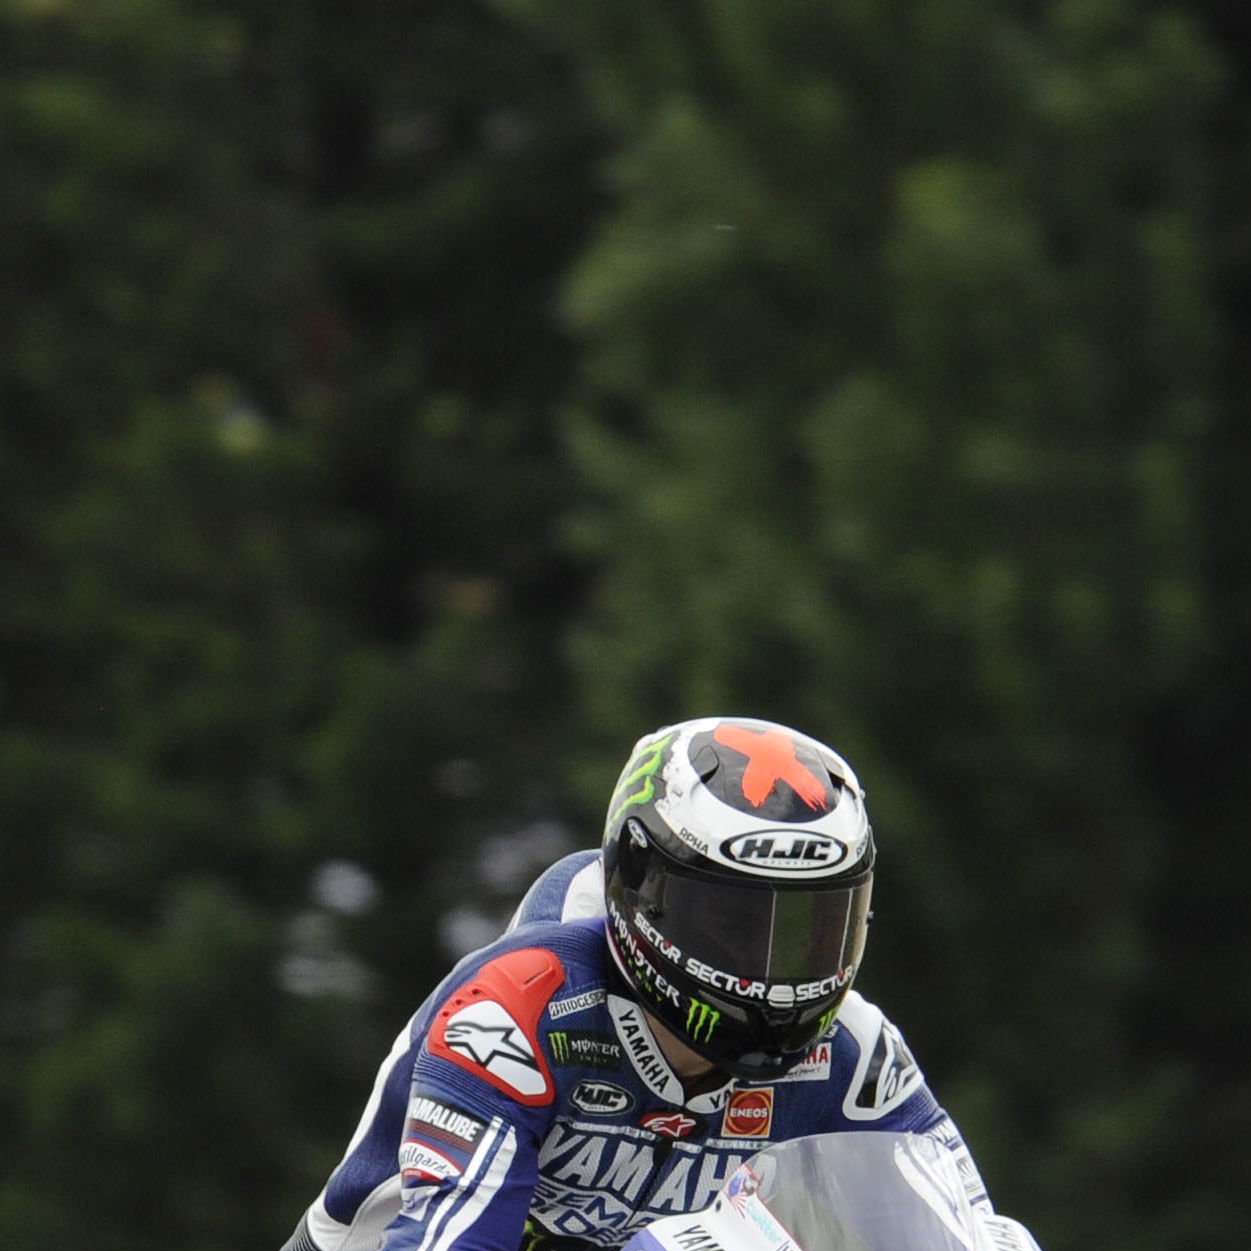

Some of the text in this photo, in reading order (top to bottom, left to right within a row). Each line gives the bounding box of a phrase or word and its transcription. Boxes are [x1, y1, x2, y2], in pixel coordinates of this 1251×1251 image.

[679, 827, 710, 856] RPHA
[738, 838, 832, 861] HJC
[609, 901, 681, 1008] MONSTER
[634, 912, 682, 965] SECTOR
[685, 958, 766, 1000] SECTOR
[795, 964, 853, 1001] SECTOR
[619, 1009, 671, 1093] YAMAHA
[409, 1096, 481, 1142] AMALUBE
[730, 1107, 768, 1119] ENEOS
